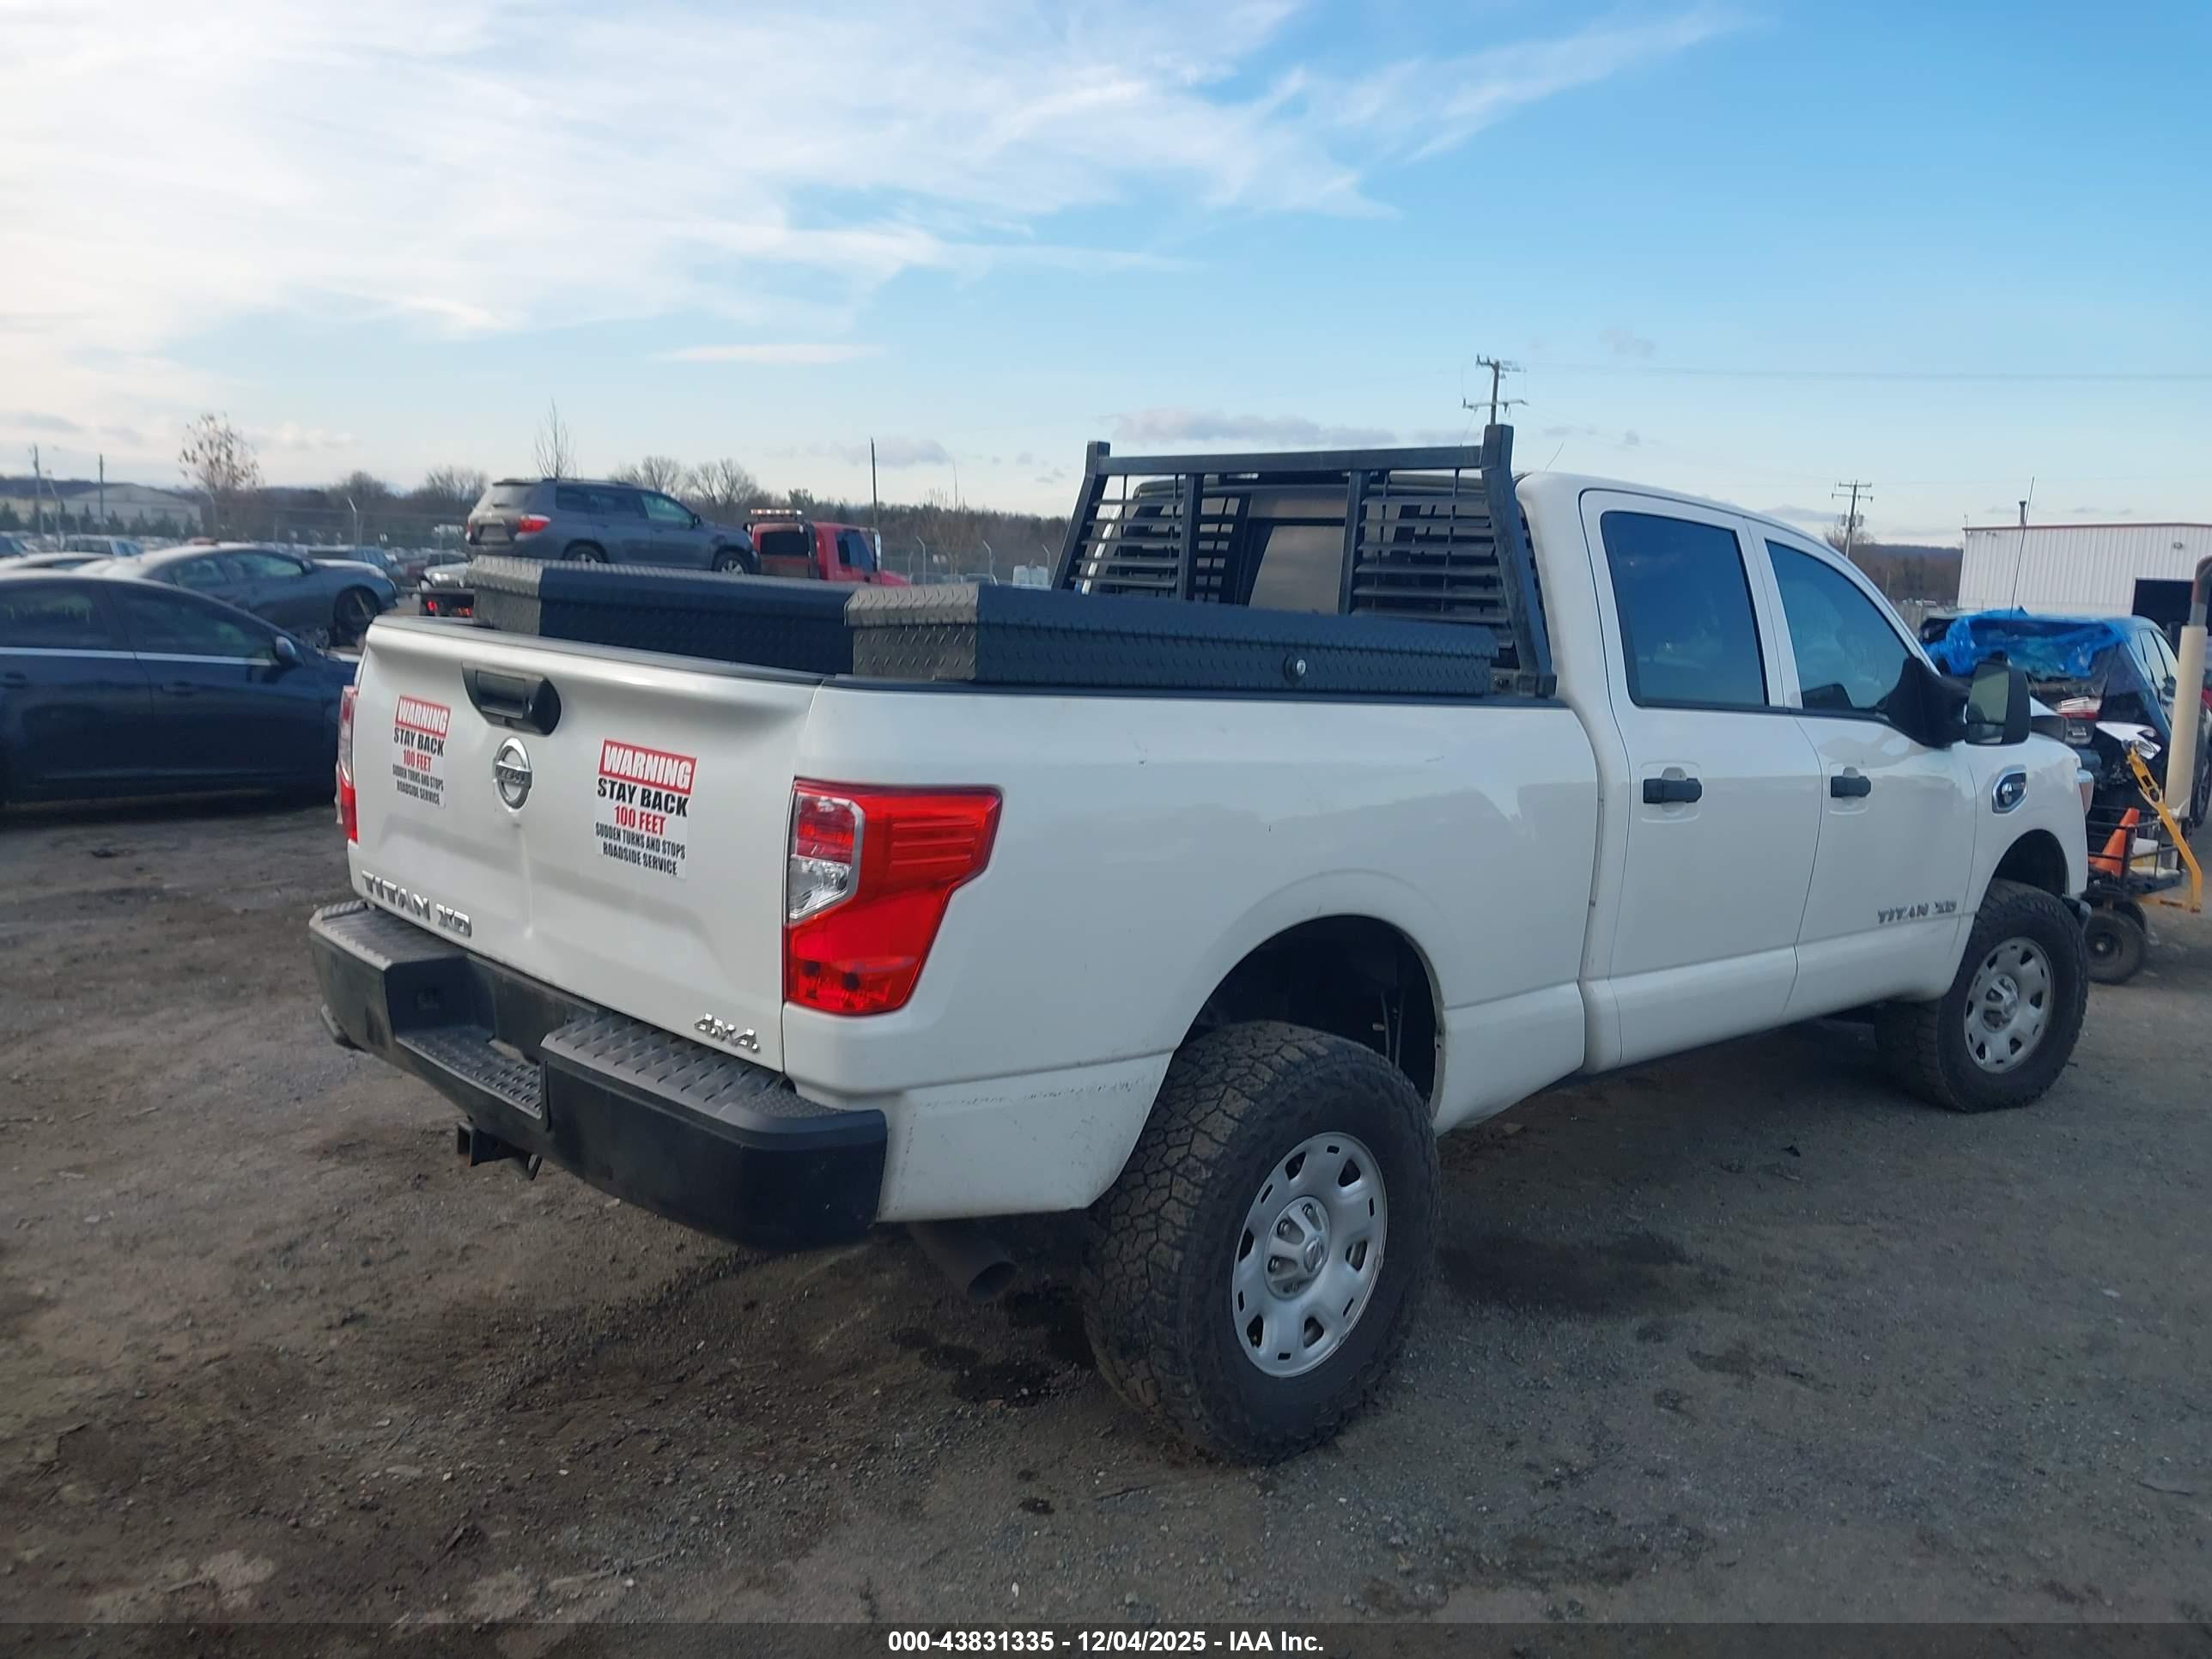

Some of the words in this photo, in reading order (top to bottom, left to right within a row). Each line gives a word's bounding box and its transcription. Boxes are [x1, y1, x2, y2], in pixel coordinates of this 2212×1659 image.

[398, 698, 450, 736] WARNING
[393, 727, 416, 749] STAY
[417, 734, 446, 757] BACK
[403, 749, 415, 768] 100
[416, 753, 432, 772] FEET
[603, 744, 692, 791] WARNING
[597, 777, 637, 805] STAY
[640, 787, 689, 817] BACK
[614, 805, 635, 829] 100
[639, 811, 666, 836] FEET
[595, 822, 621, 842] SUDDEN
[623, 829, 644, 848] TURNS
[646, 836, 660, 854] AND
[661, 841, 685, 860] STOPS
[603, 841, 641, 866] ROADSIDE
[642, 853, 678, 876] SERVICE
[361, 869, 431, 921] TITAN
[435, 902, 472, 938] XD
[1877, 902, 1929, 924] TITAN
